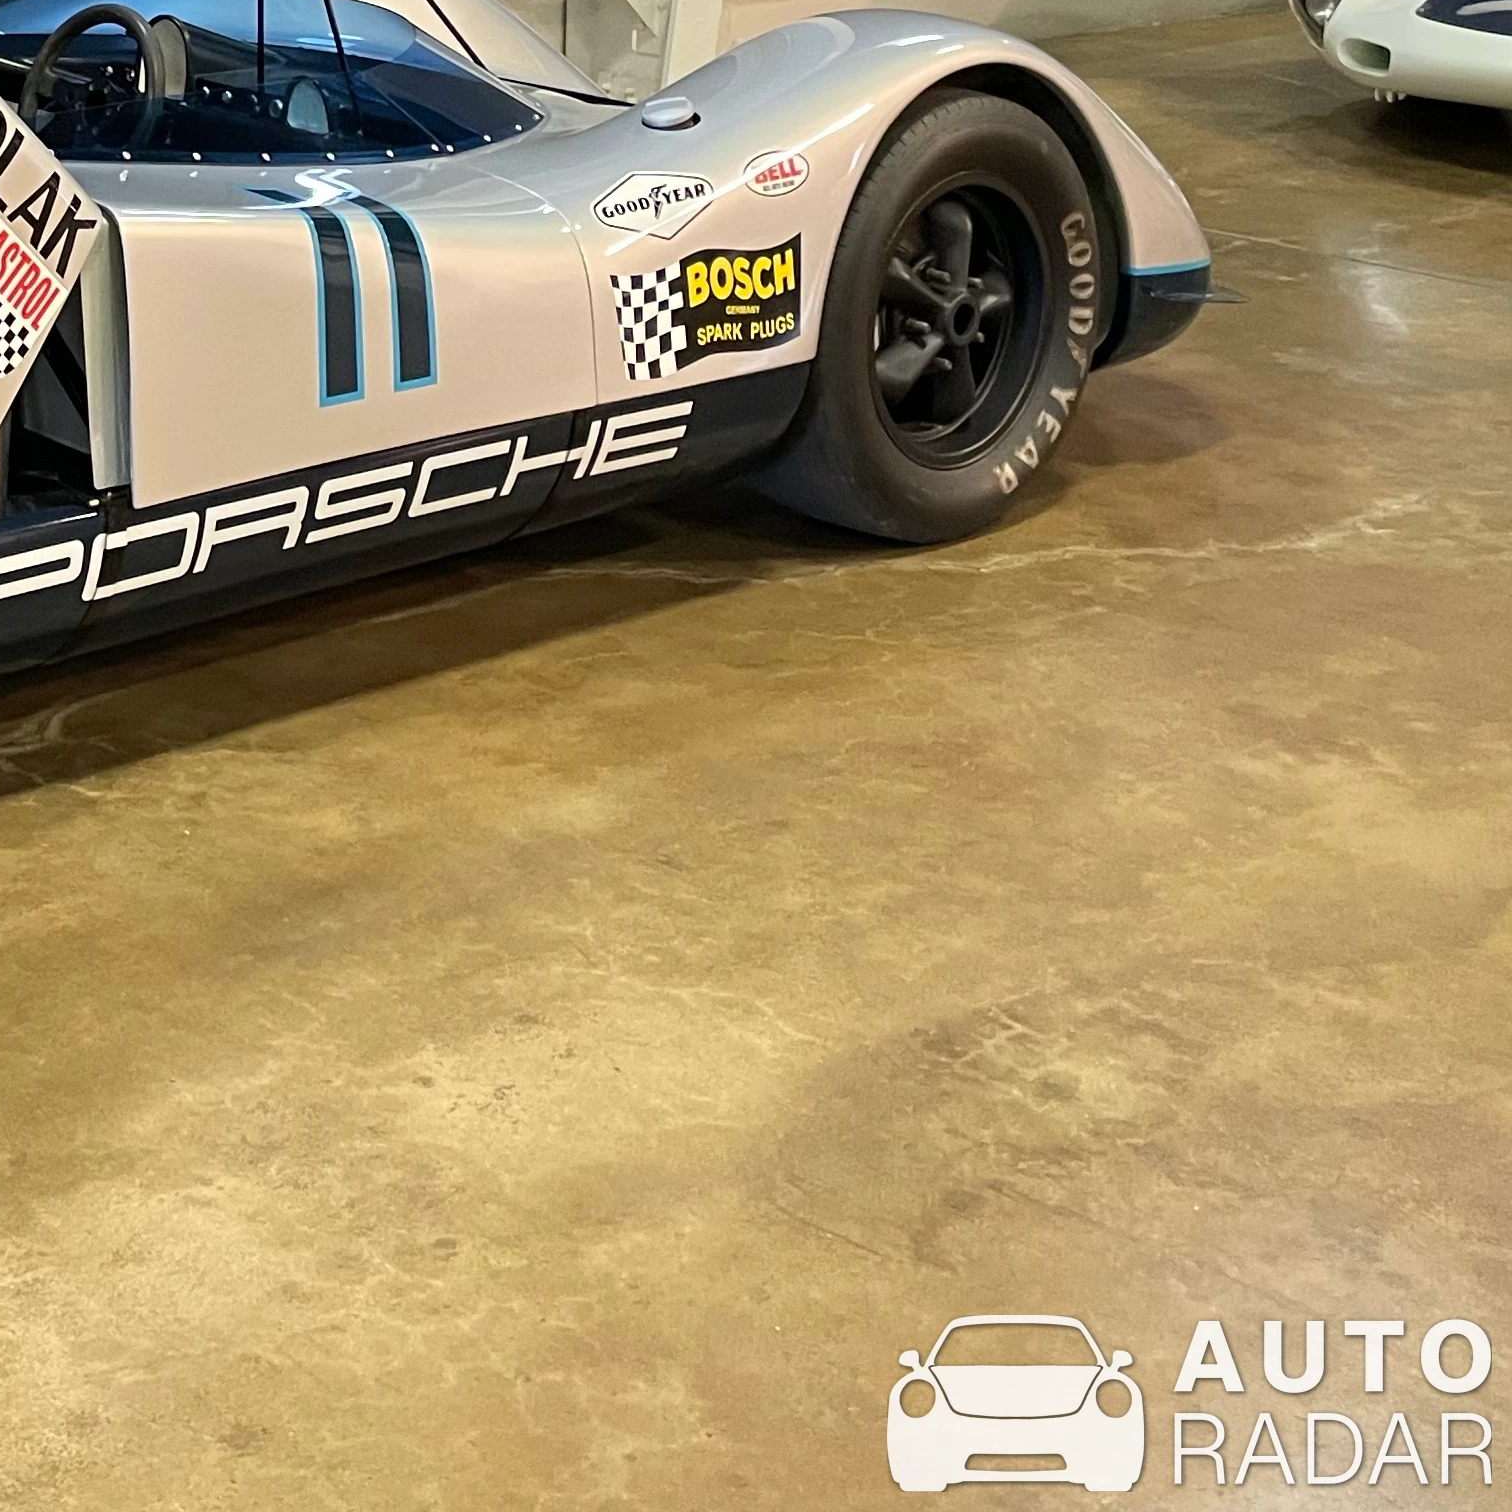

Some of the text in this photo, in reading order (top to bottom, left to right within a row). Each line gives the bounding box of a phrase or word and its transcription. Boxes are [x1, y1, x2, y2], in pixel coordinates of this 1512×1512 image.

[687, 248, 796, 308] BOSCH
[697, 312, 795, 346] SPARK PLUGS
